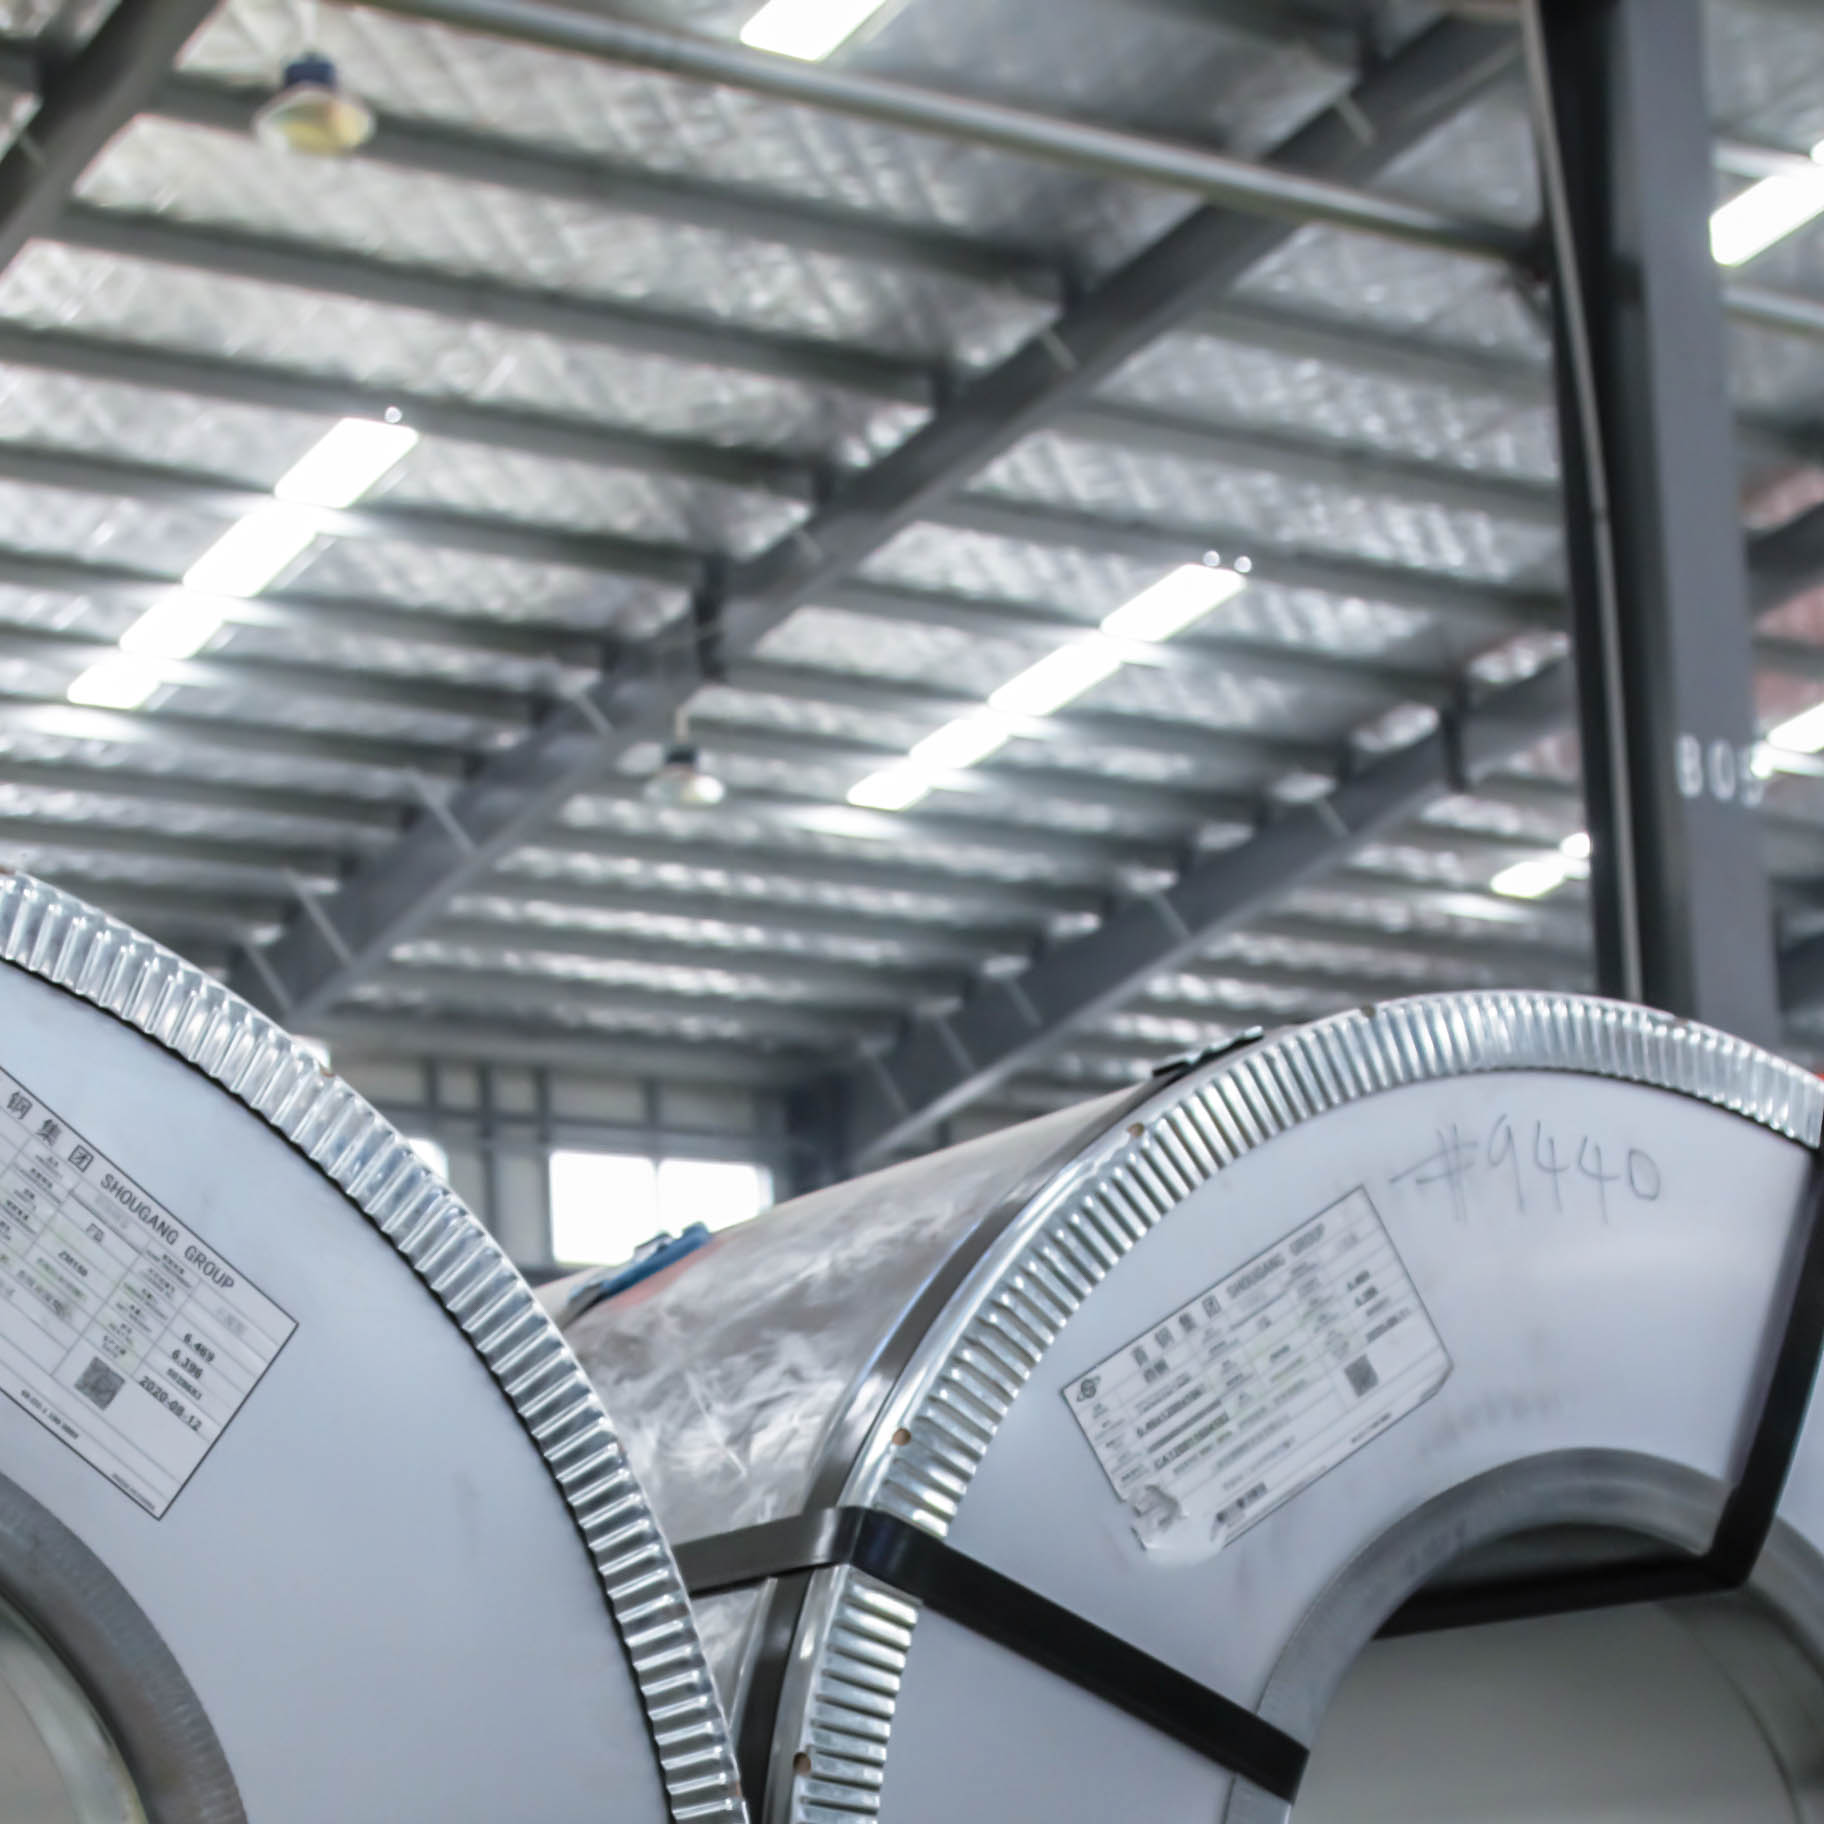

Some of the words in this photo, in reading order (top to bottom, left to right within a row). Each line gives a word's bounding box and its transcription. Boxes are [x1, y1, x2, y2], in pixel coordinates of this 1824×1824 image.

[1389, 1113, 1661, 1226] #9440
[98, 1171, 181, 1247] SHOUGANG
[181, 1242, 236, 1294] GROUP
